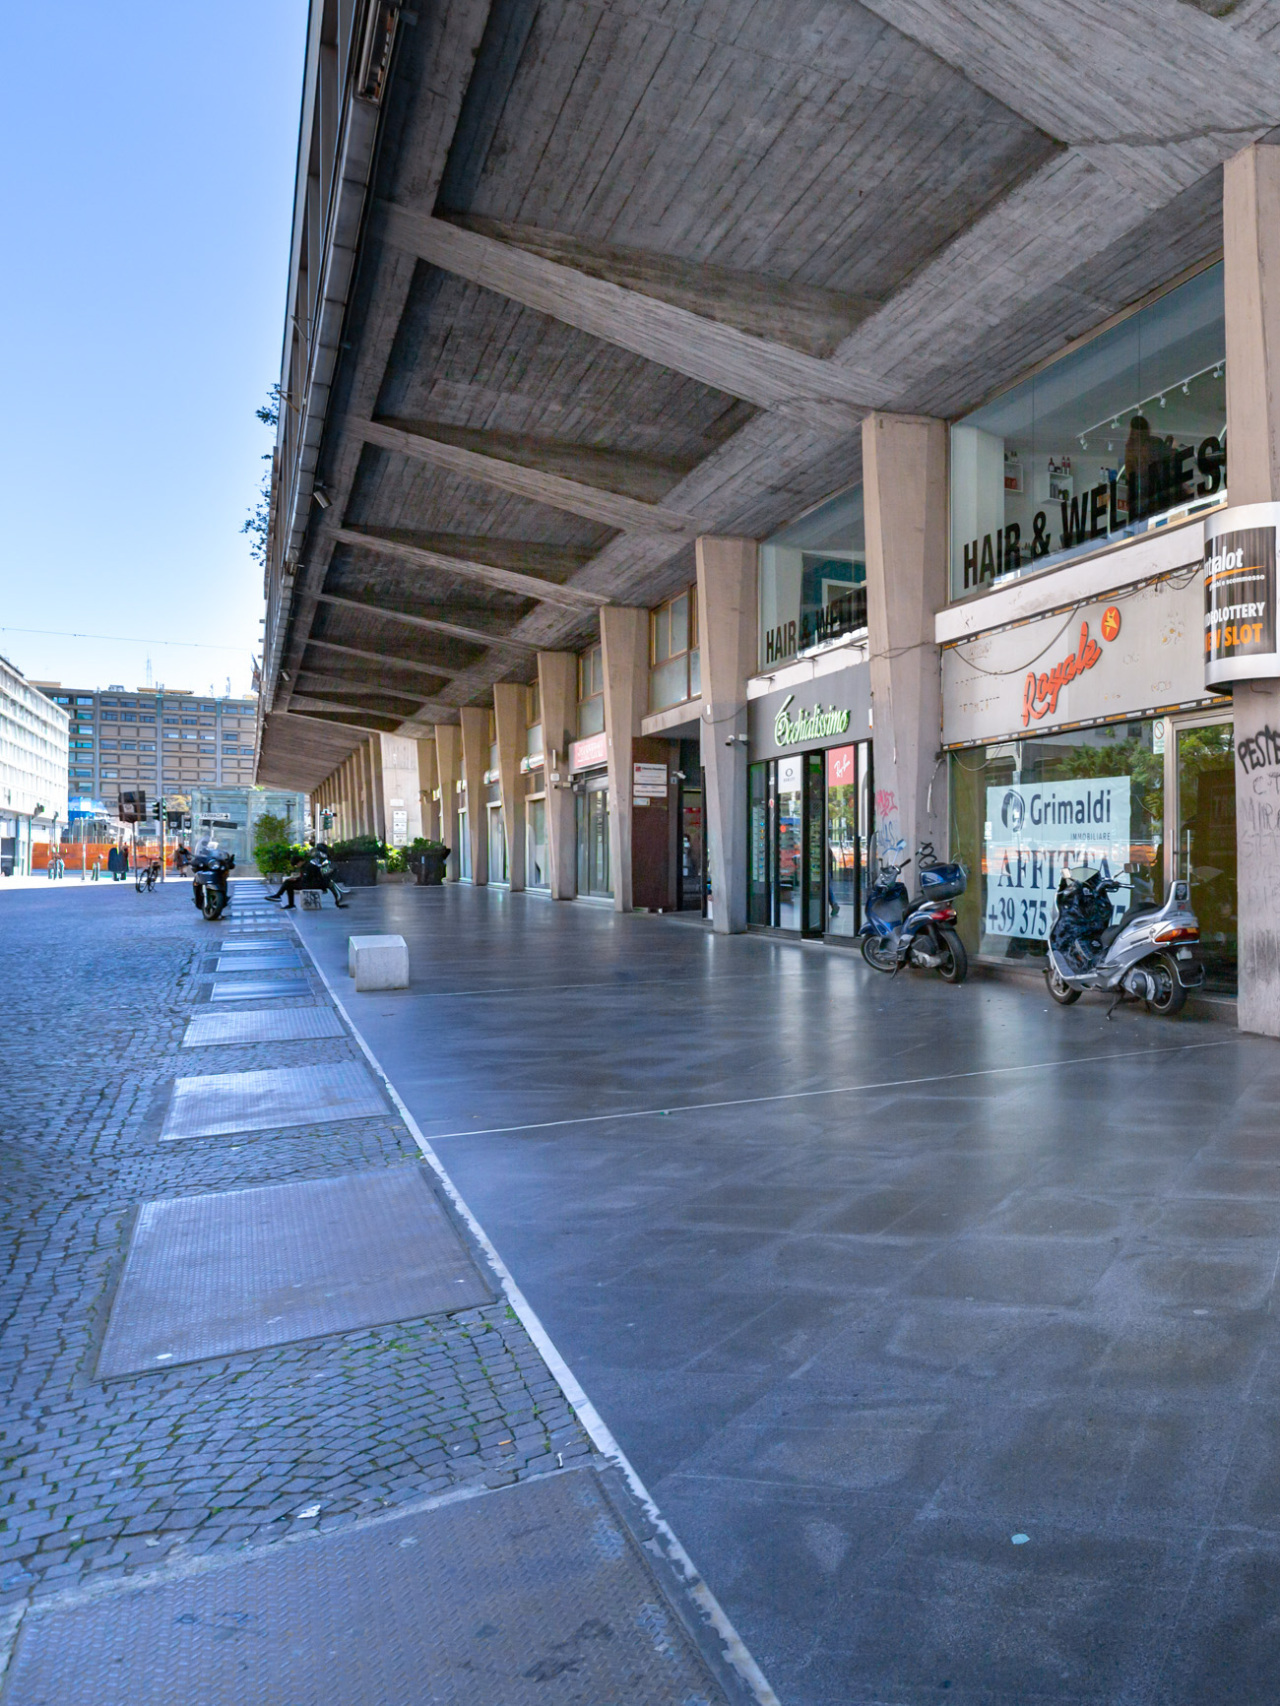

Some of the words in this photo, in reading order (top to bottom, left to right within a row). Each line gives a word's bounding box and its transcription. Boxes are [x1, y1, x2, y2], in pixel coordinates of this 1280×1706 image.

[964, 522, 1021, 590] HAIR
[1032, 511, 1051, 556] &
[1060, 435, 1227, 549] WELLES
[766, 620, 797, 664] HAIR
[1224, 622, 1263, 648] SLOT
[1021, 621, 1103, 727] Royale
[774, 694, 851, 747] Occhialissimo
[1029, 789, 1111, 826] Grimaldi
[1069, 832, 1111, 841] IMMOBILIARE
[988, 896, 1016, 934] +39
[1019, 898, 1047, 936] 375
